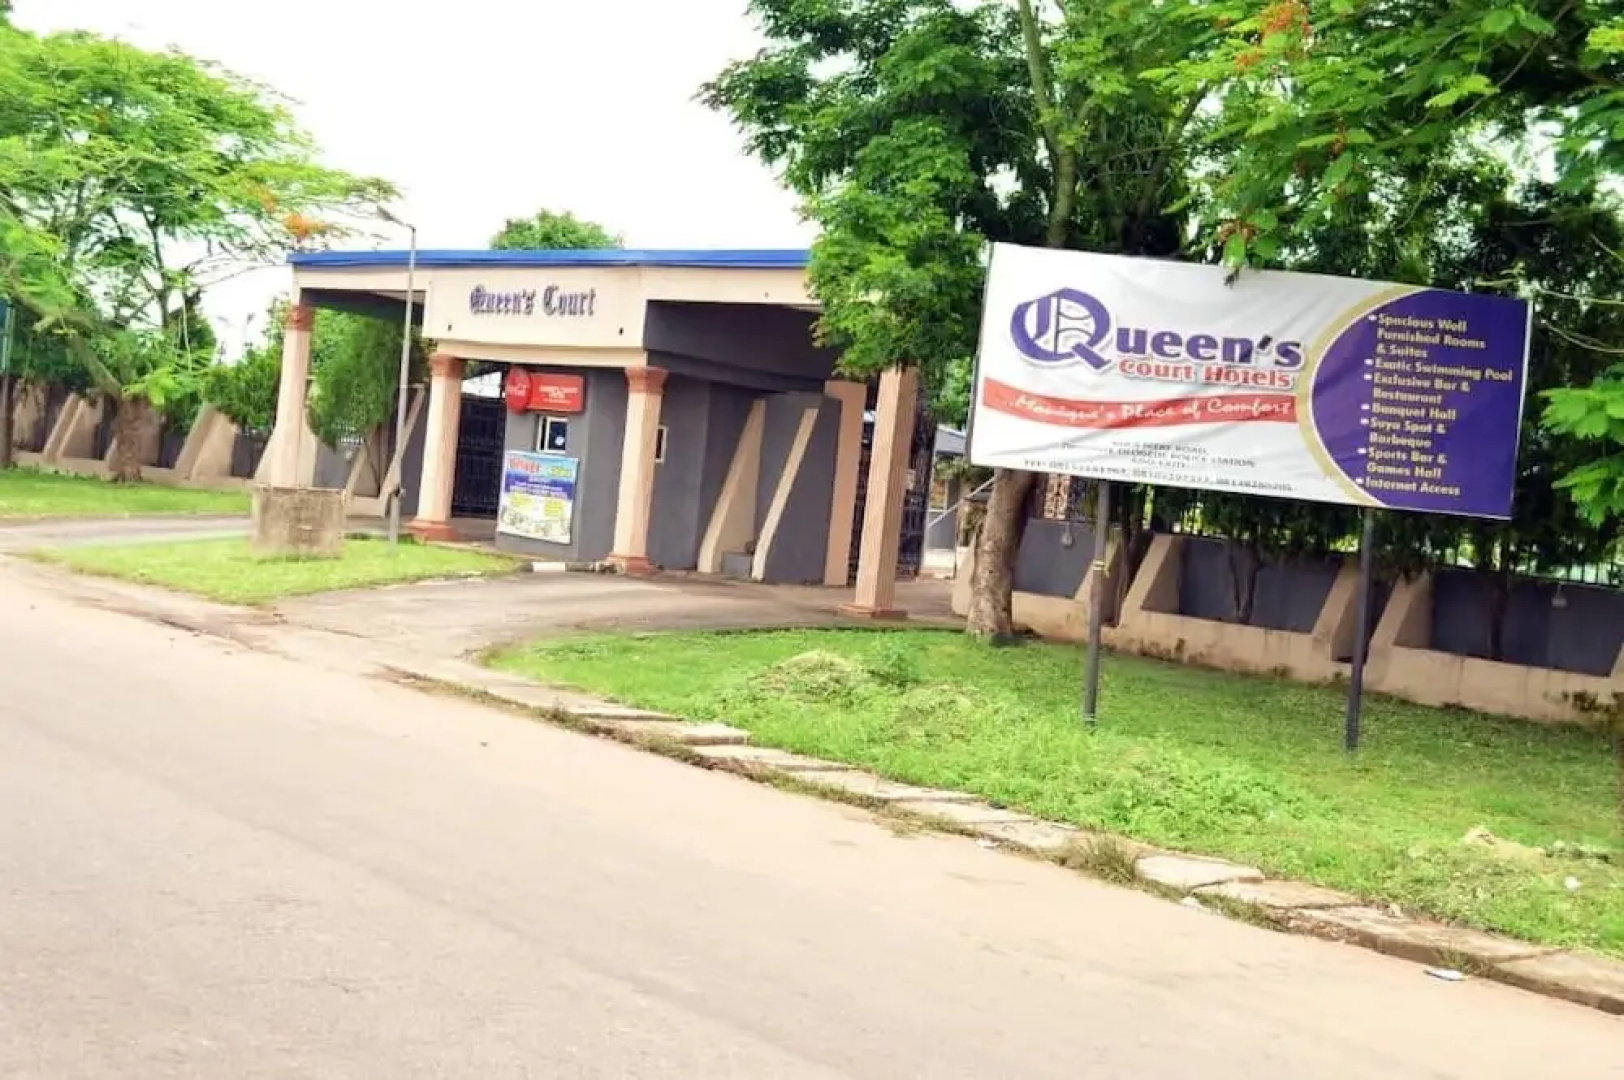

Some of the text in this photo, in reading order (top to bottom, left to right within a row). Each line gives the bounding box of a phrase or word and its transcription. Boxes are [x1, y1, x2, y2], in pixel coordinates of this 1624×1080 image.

[470, 284, 596, 316] Queen's Court
[1010, 288, 1304, 370] Queen's
[1378, 313, 1467, 332] Spacious Well
[1377, 328, 1486, 349] Furnished Rooms
[1377, 344, 1428, 358] & Suites
[1119, 359, 1291, 387] Court Hotels
[1375, 358, 1513, 381] Exotic Swimming Pool
[1374, 372, 1470, 393] Exclusive Bar &
[1373, 387, 1443, 404] Restaurant
[1122, 403, 1176, 419] Place
[1181, 398, 1201, 419] of
[1207, 398, 1292, 417] Comfort
[1372, 403, 1456, 420] Banquet Hall
[1370, 417, 1446, 434] Suya Spot &
[1369, 431, 1432, 448] Barbeque
[1368, 447, 1447, 464] Sports Bar &
[1366, 462, 1442, 478] Games Hall
[1365, 476, 1461, 496] Internet Access
